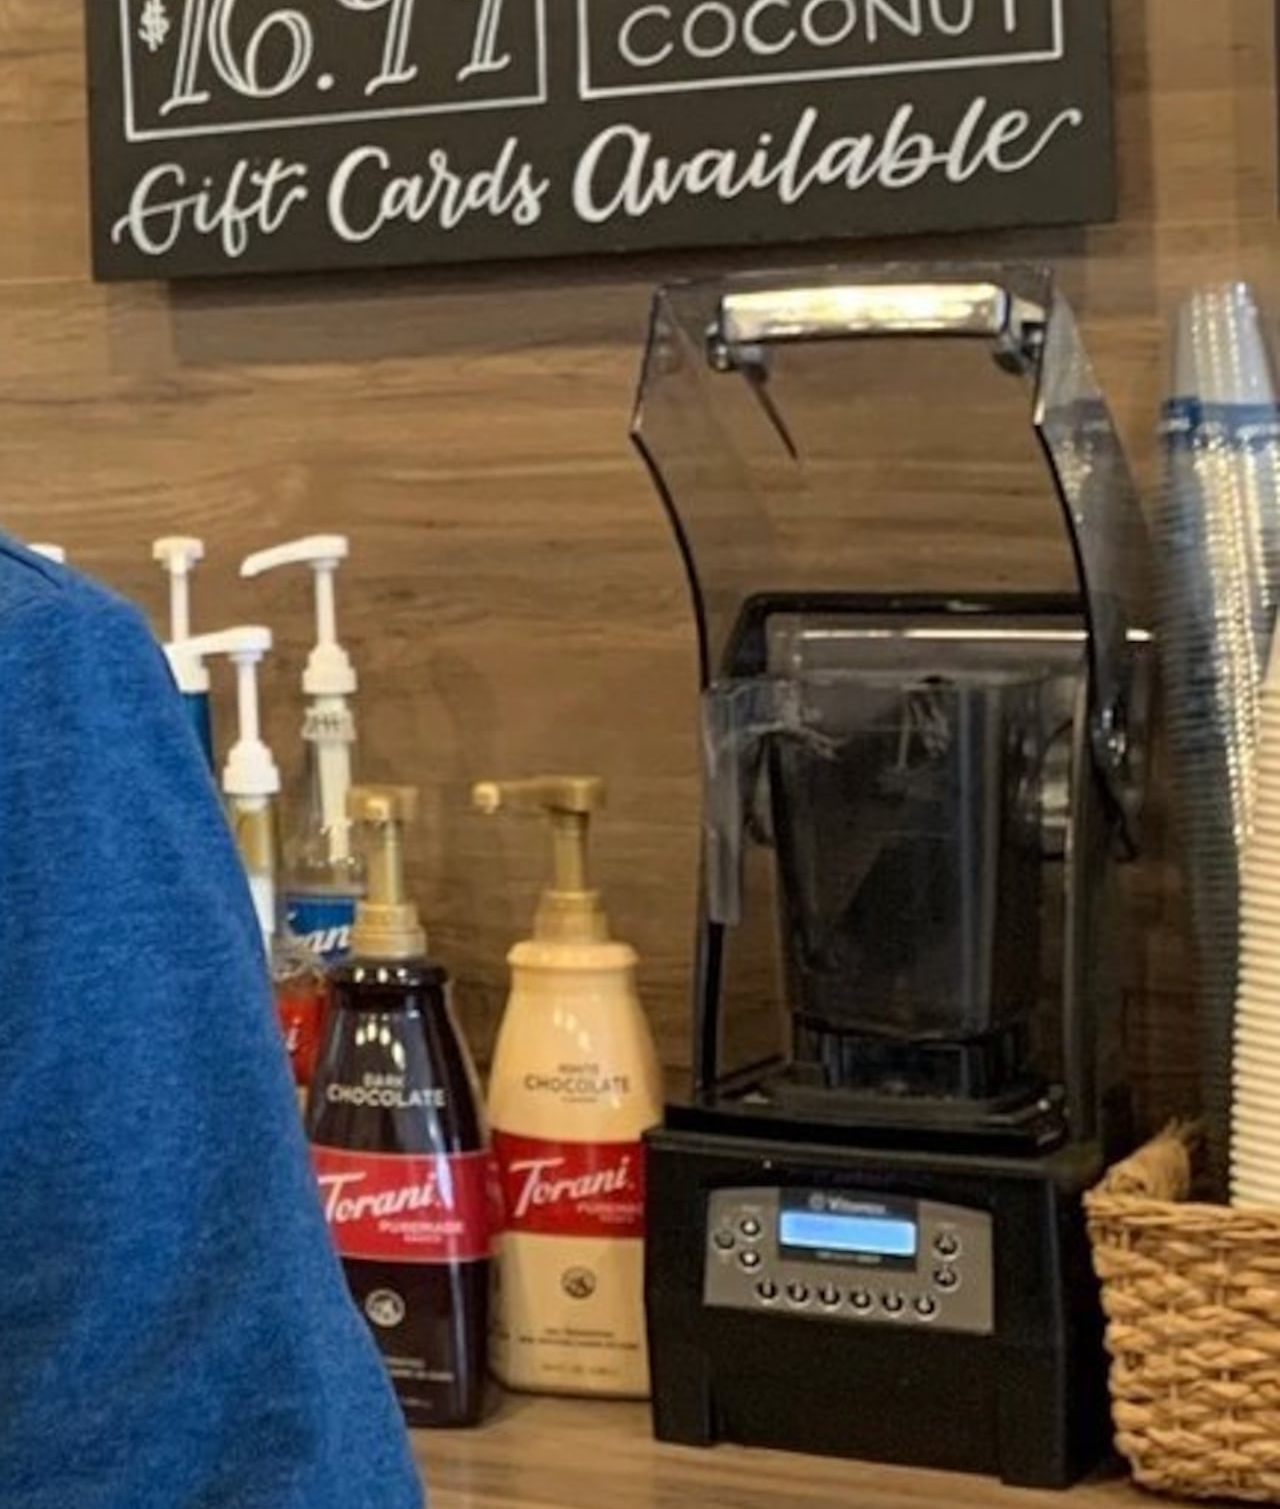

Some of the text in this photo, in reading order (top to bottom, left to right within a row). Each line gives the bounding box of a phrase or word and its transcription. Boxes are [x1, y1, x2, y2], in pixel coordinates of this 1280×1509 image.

[110, 94, 1082, 259] Gift Cards Available
[325, 1083, 447, 1109] CHOCOLATE
[524, 1073, 630, 1095] CHOCOLATE
[316, 1171, 438, 1225] Torani
[509, 1155, 632, 1220] Torani
